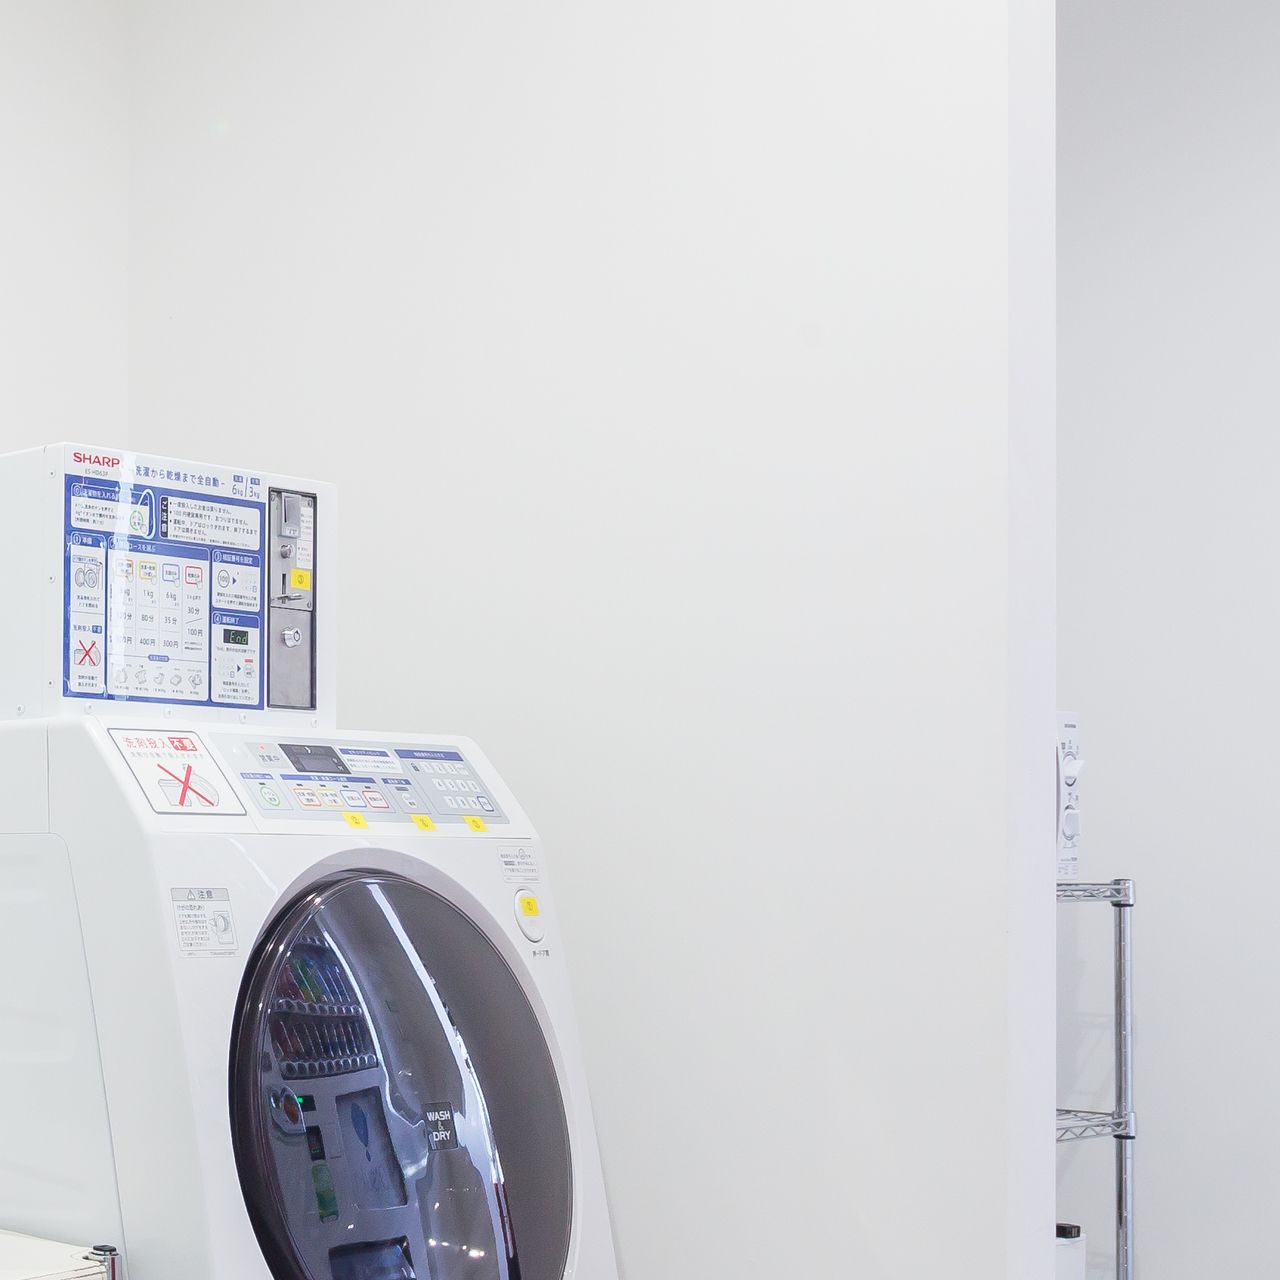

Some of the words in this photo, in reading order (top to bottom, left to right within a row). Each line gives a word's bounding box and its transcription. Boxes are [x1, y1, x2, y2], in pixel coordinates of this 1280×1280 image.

[73, 452, 120, 467] SHARP
[230, 631, 248, 644] End
[427, 1111, 450, 1121] WASH
[432, 1131, 450, 1141] DRY
